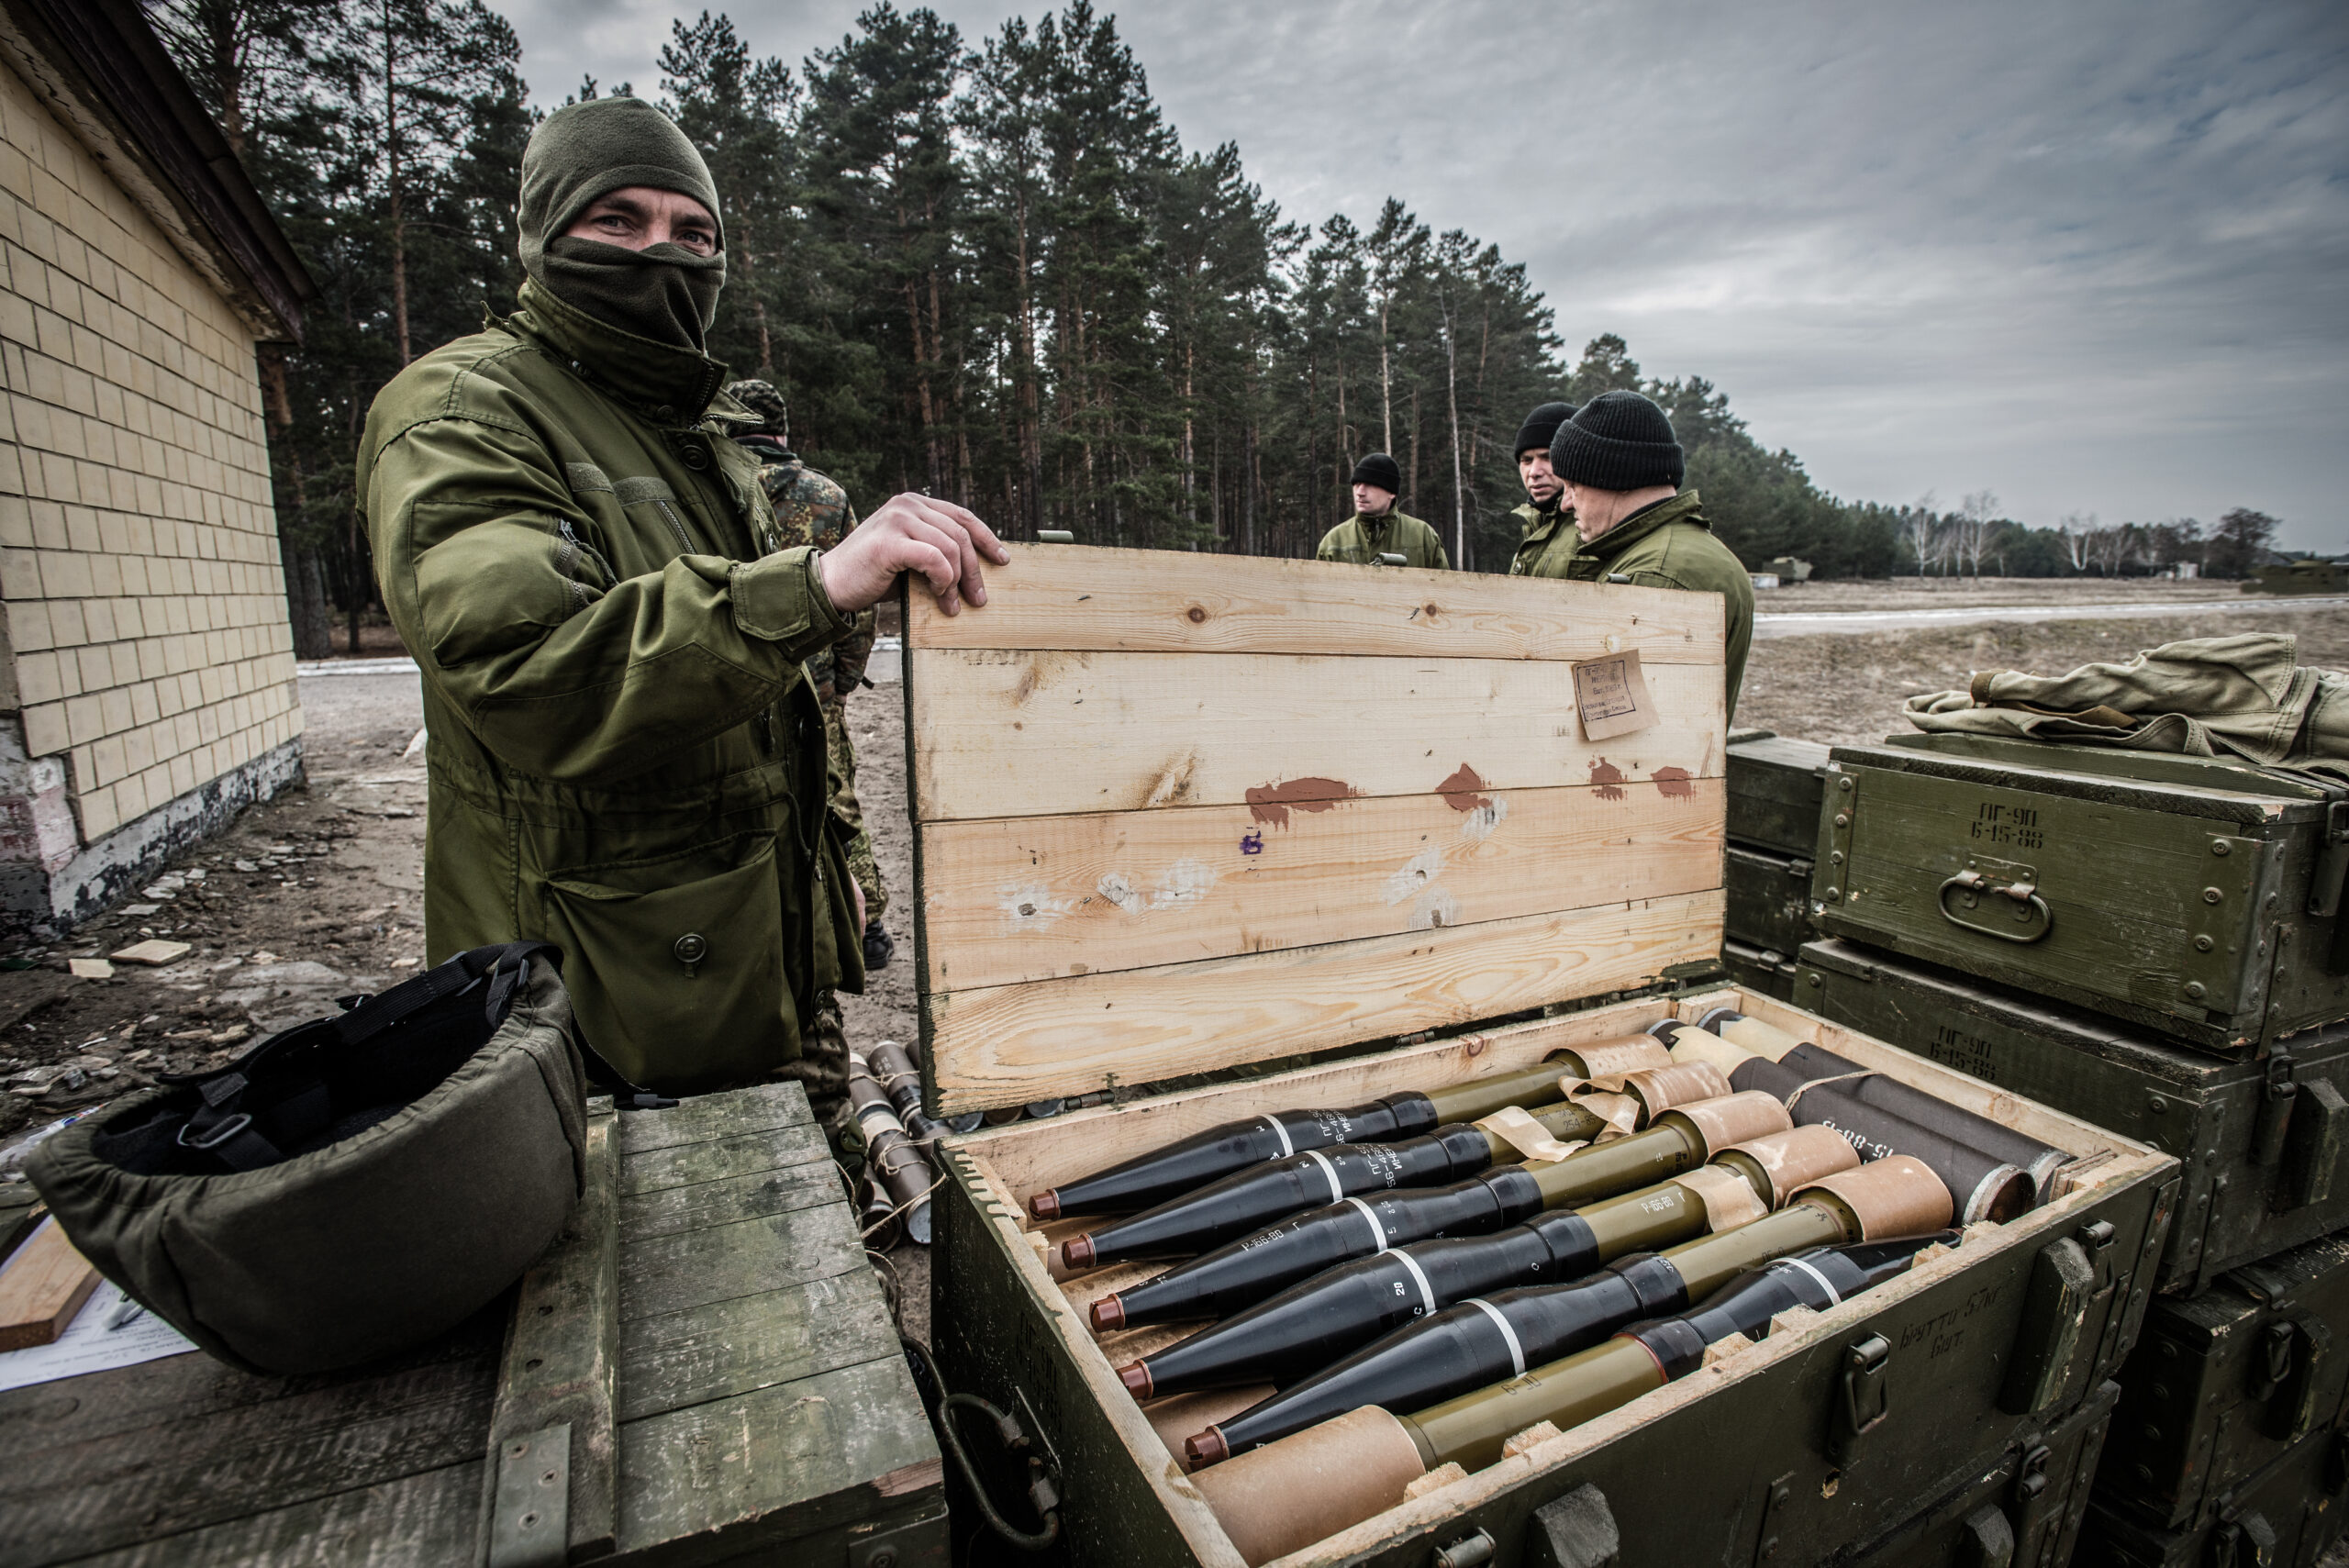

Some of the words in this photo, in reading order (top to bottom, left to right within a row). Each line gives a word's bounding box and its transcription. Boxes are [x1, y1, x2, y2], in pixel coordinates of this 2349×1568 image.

[1979, 803, 2037, 827] ПГ-9П
[1971, 821, 2043, 850] Б-15-88
[1938, 1025, 1992, 1059] ПГ-9П
[1930, 1041, 1996, 1080] Б-15-88
